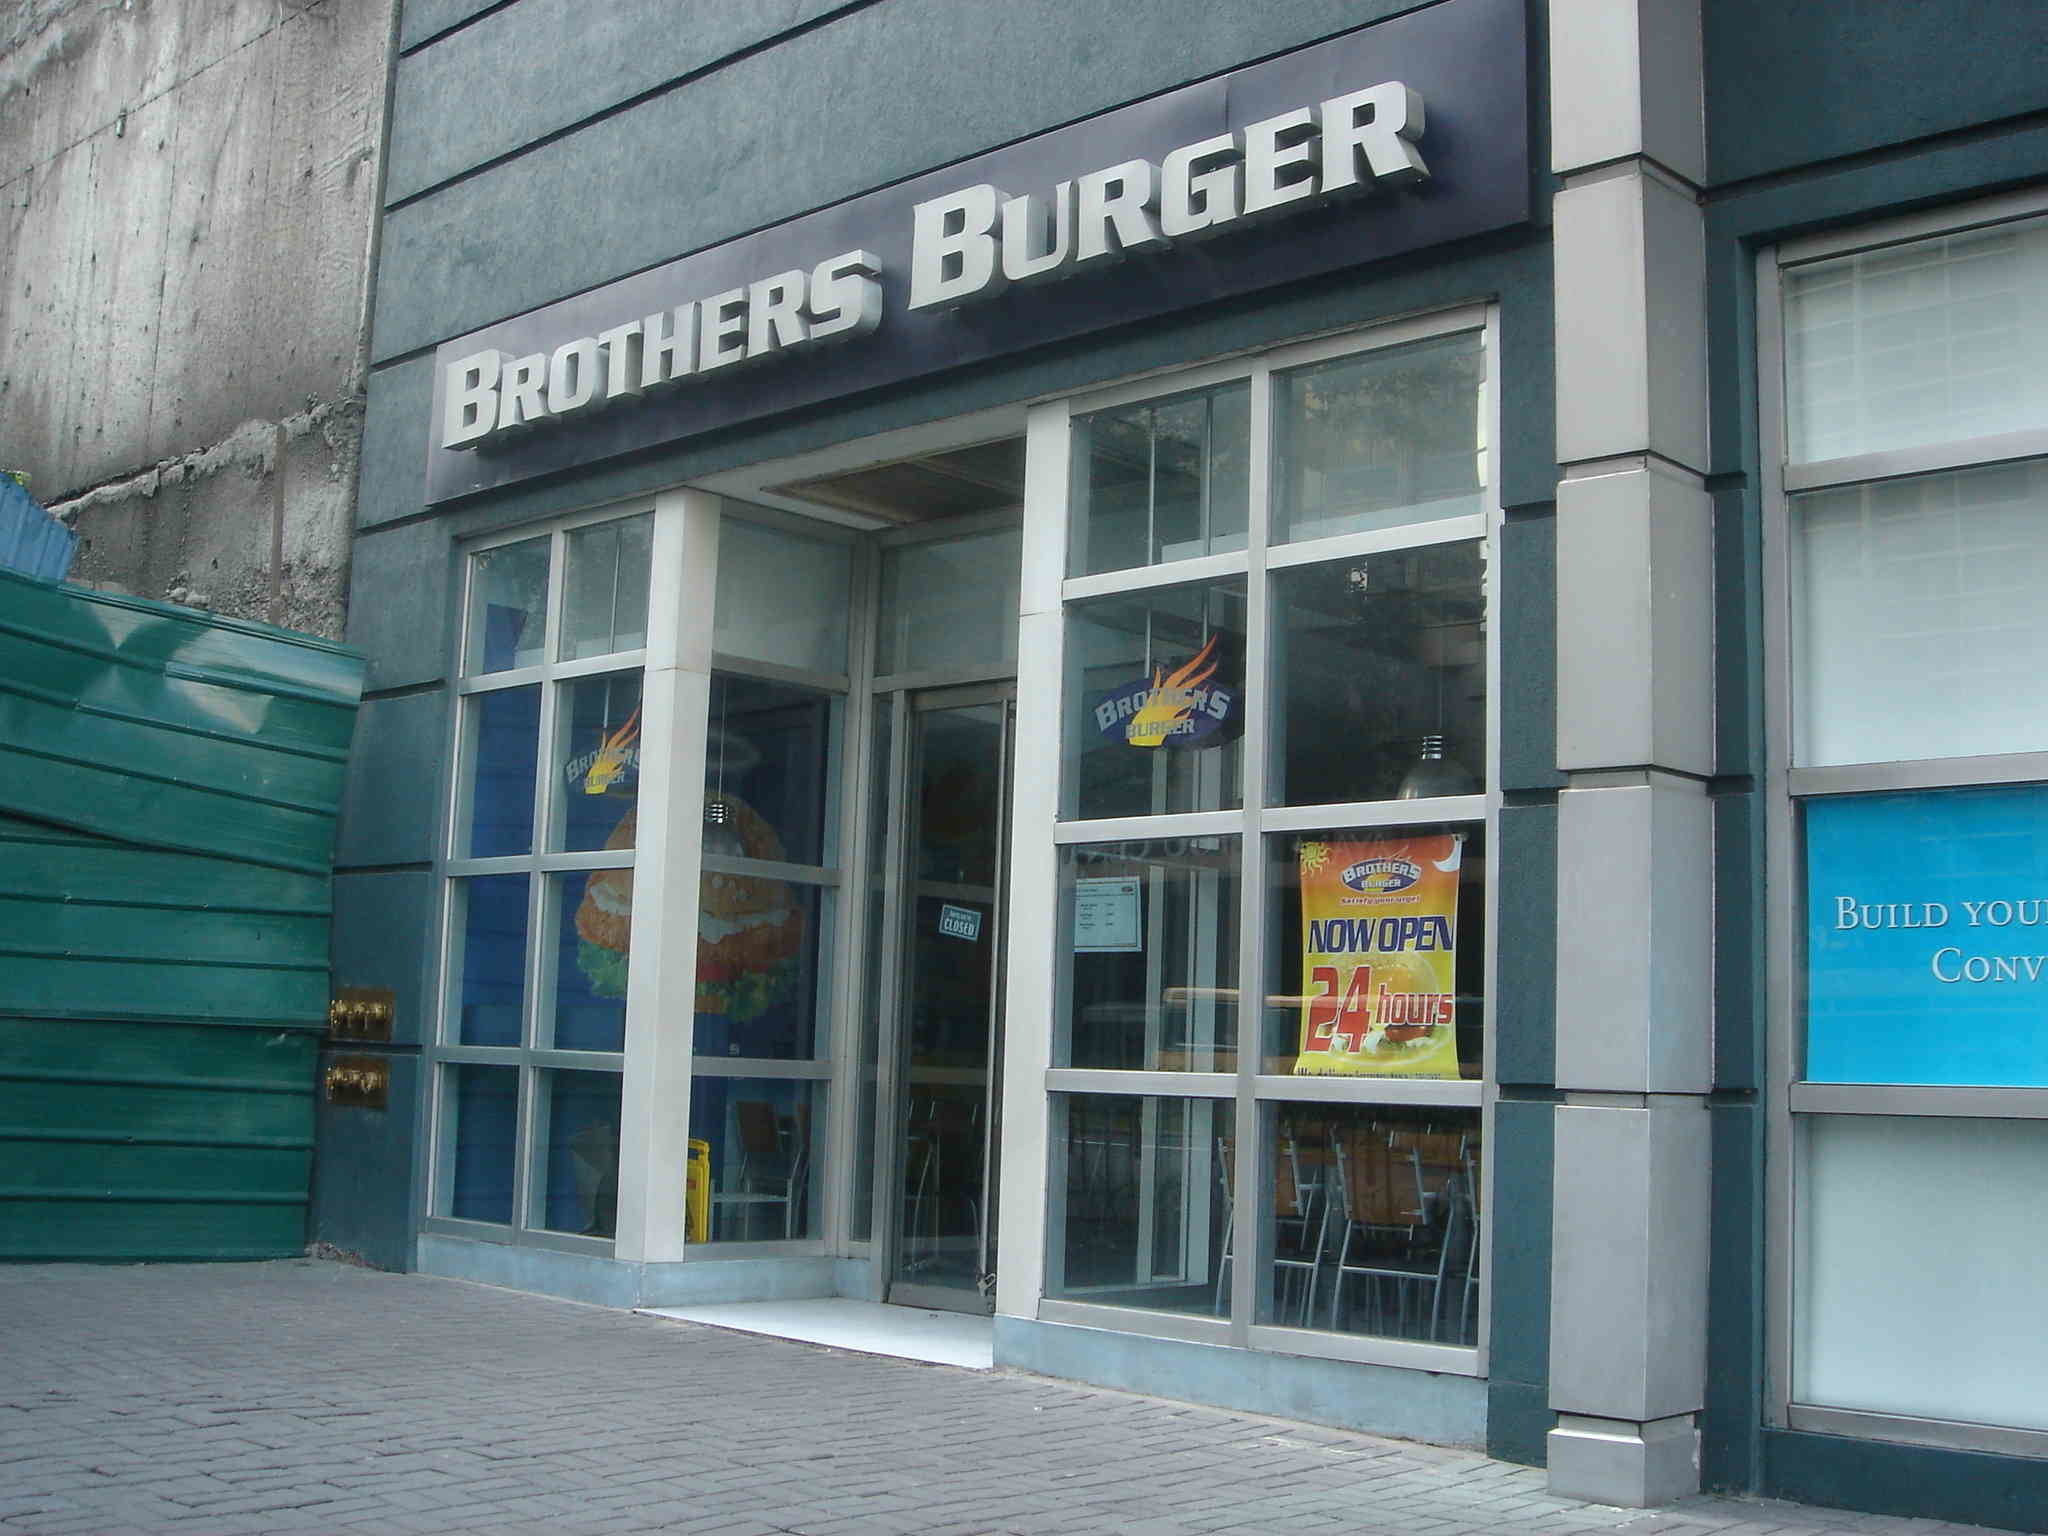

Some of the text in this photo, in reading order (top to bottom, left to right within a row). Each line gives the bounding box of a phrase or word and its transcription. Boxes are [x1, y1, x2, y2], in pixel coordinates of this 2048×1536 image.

[442, 80, 1430, 452] BROTHERS BURGER
[1343, 862, 1422, 883] BROTHERS
[944, 917, 975, 936] CLOSED
[1835, 896, 2048, 929] BUILD YOU
[1308, 916, 1454, 954] NOW OPEN
[1304, 965, 1454, 1054] 24 hours
